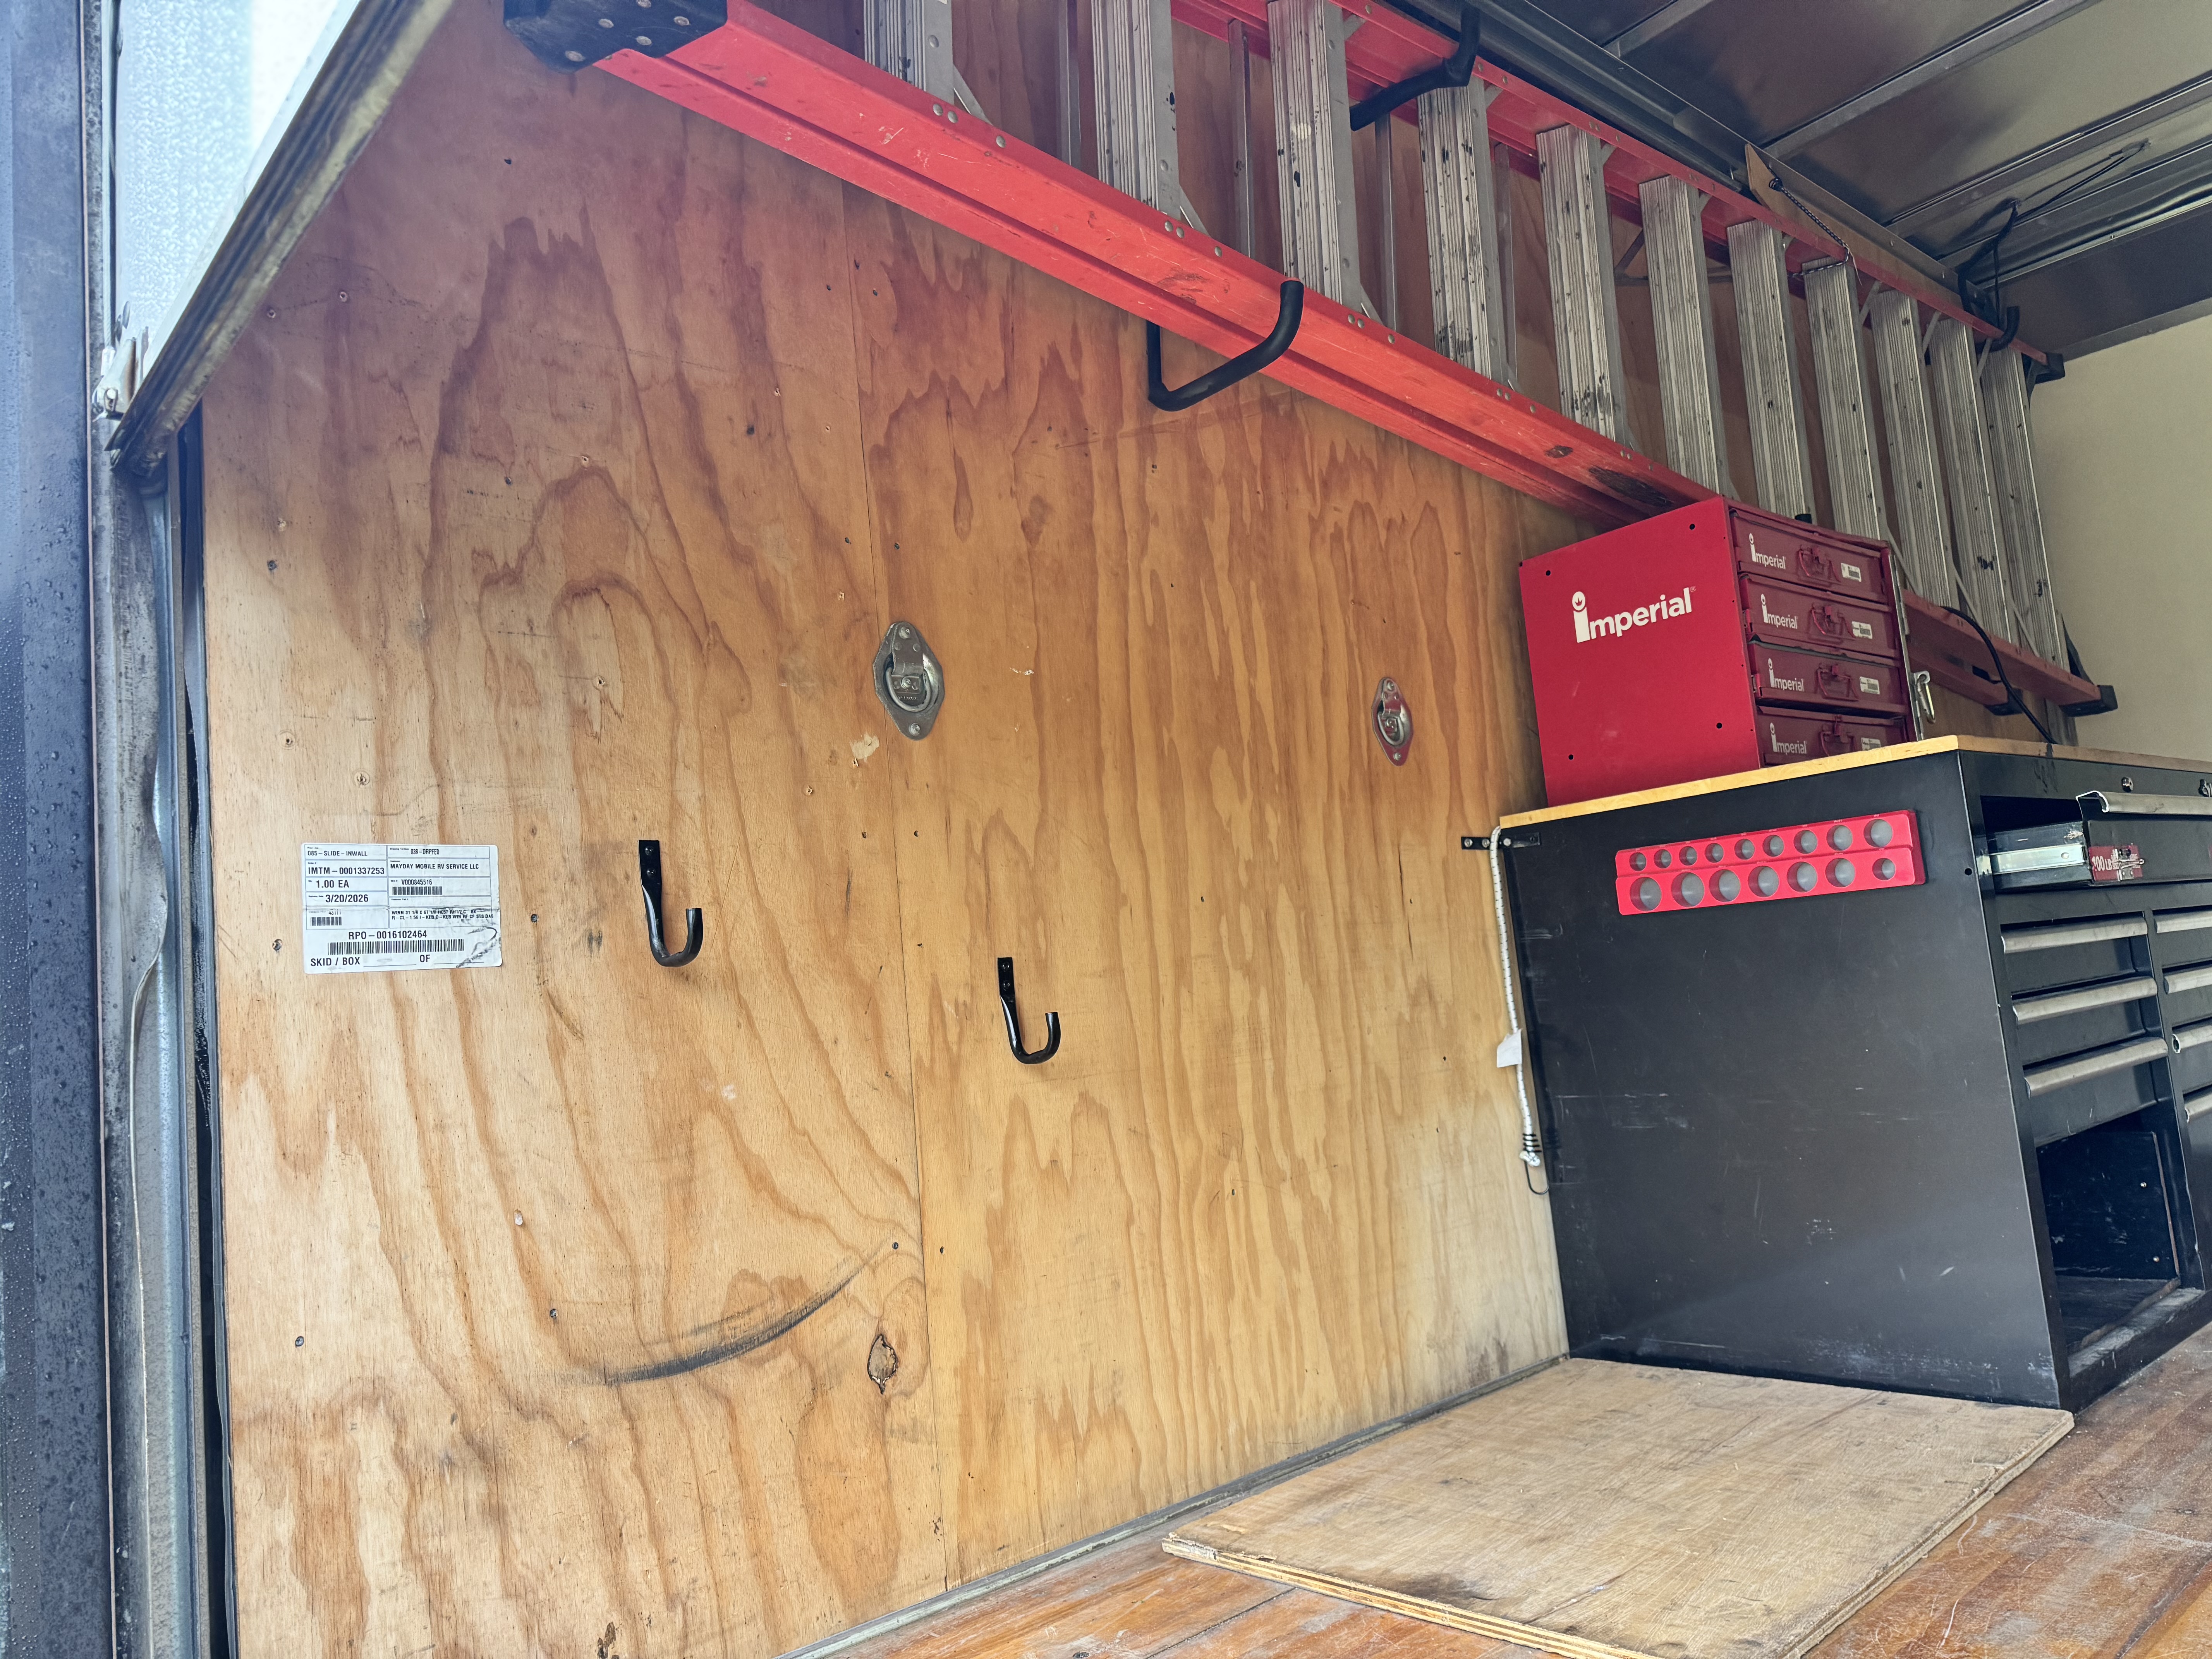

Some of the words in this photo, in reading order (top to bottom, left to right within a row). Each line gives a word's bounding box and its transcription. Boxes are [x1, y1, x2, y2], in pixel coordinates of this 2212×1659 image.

[2092, 855, 2105, 871] 100
[316, 879, 334, 888] 1.00
[338, 879, 349, 888] EA
[325, 894, 369, 903] 3/20/2026
[311, 958, 332, 966] SKID
[335, 957, 338, 966] /
[342, 957, 360, 965] BOX
[419, 954, 431, 963] OF
